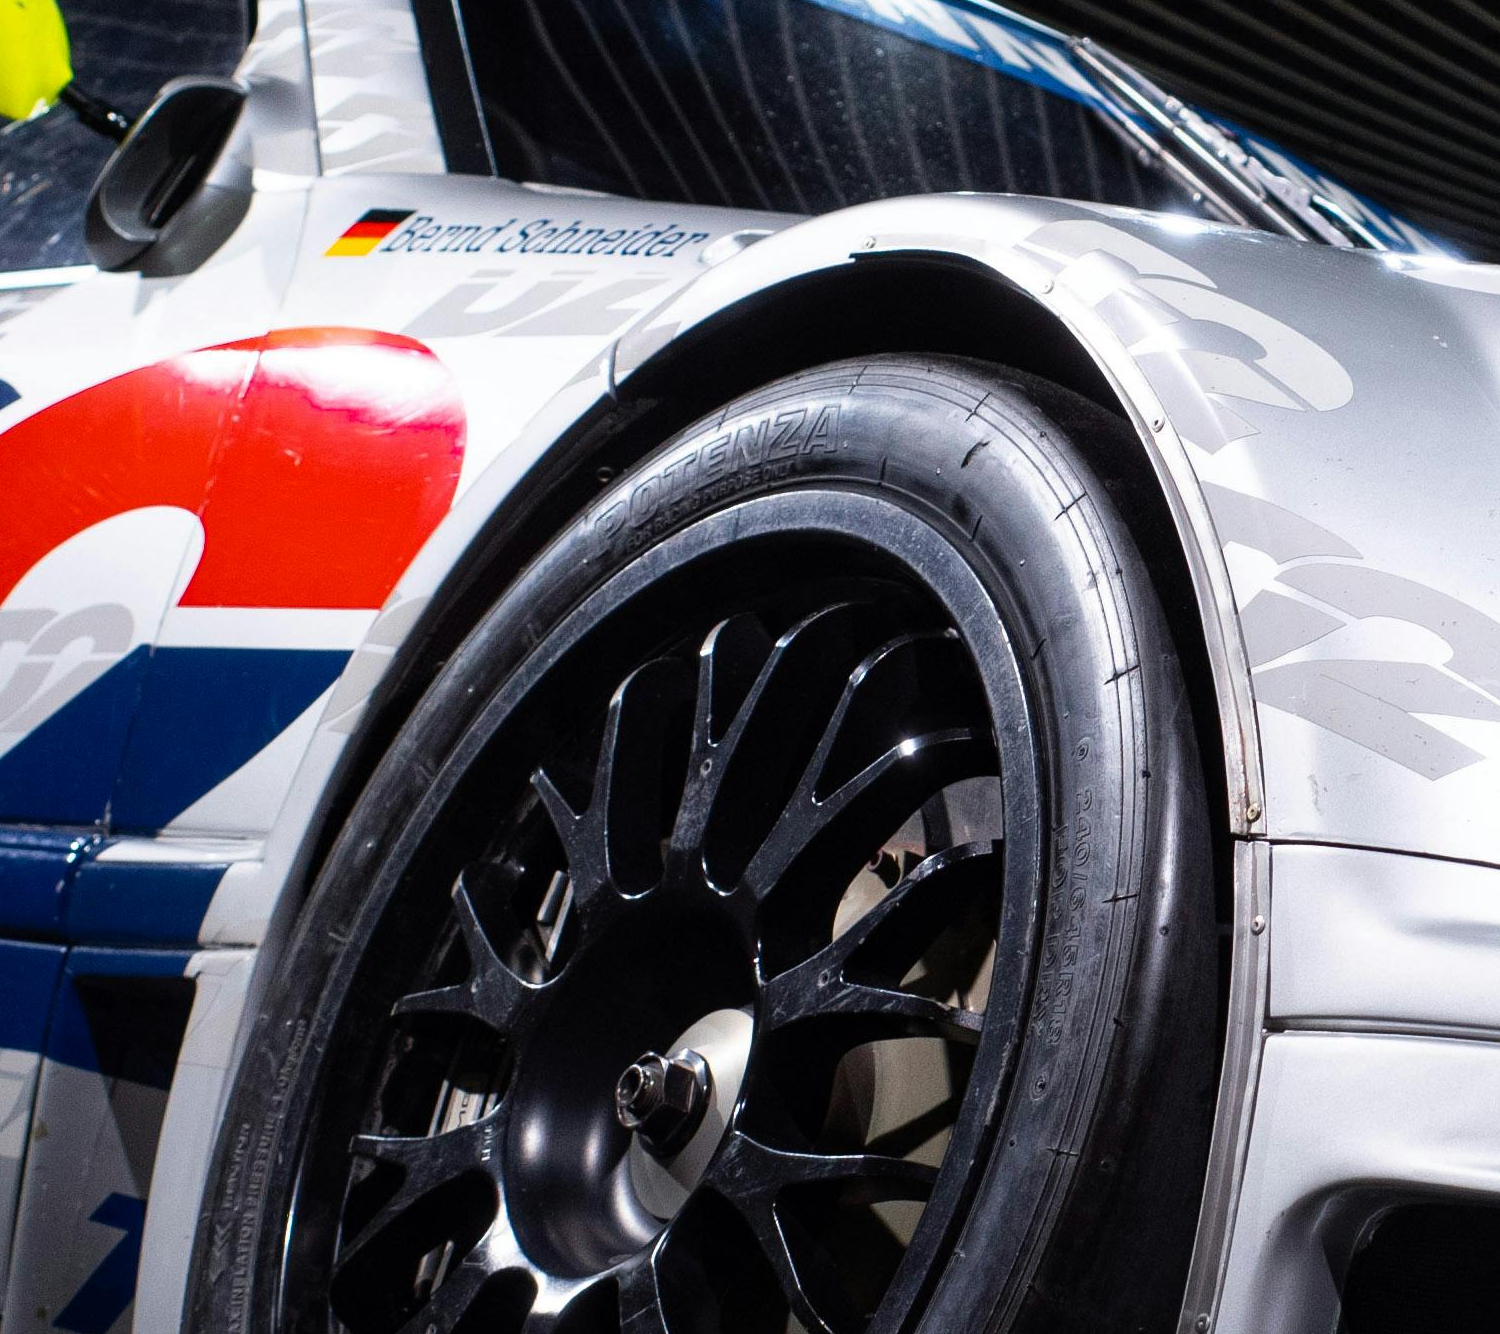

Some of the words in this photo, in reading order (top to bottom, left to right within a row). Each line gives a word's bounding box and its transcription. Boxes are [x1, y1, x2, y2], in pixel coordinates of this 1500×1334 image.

[380, 215, 503, 254] Bernd
[500, 216, 712, 259] Schneider
[594, 403, 842, 560] POTENZA
